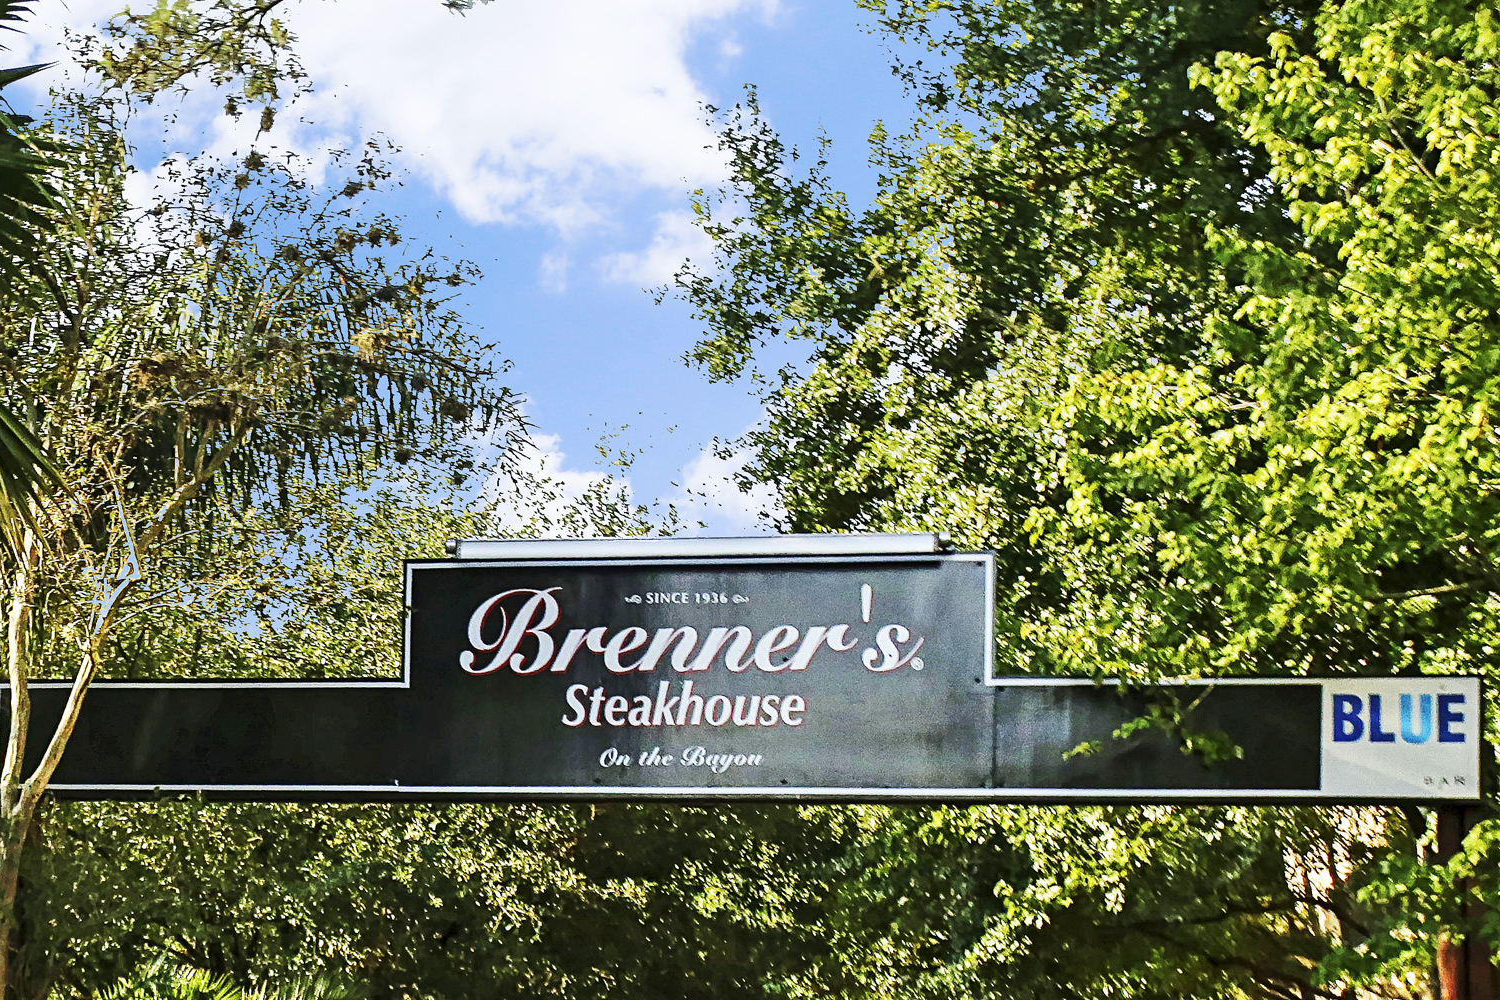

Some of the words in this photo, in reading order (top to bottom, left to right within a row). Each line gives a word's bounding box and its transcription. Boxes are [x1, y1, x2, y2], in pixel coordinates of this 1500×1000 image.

[645, 591, 689, 604] SINCE
[694, 591, 728, 604] 1936
[561, 679, 807, 728] Steakhouse
[1332, 693, 1467, 744] BLUE
[600, 747, 632, 768] On
[638, 745, 674, 767] the
[679, 745, 764, 774] Bayou
